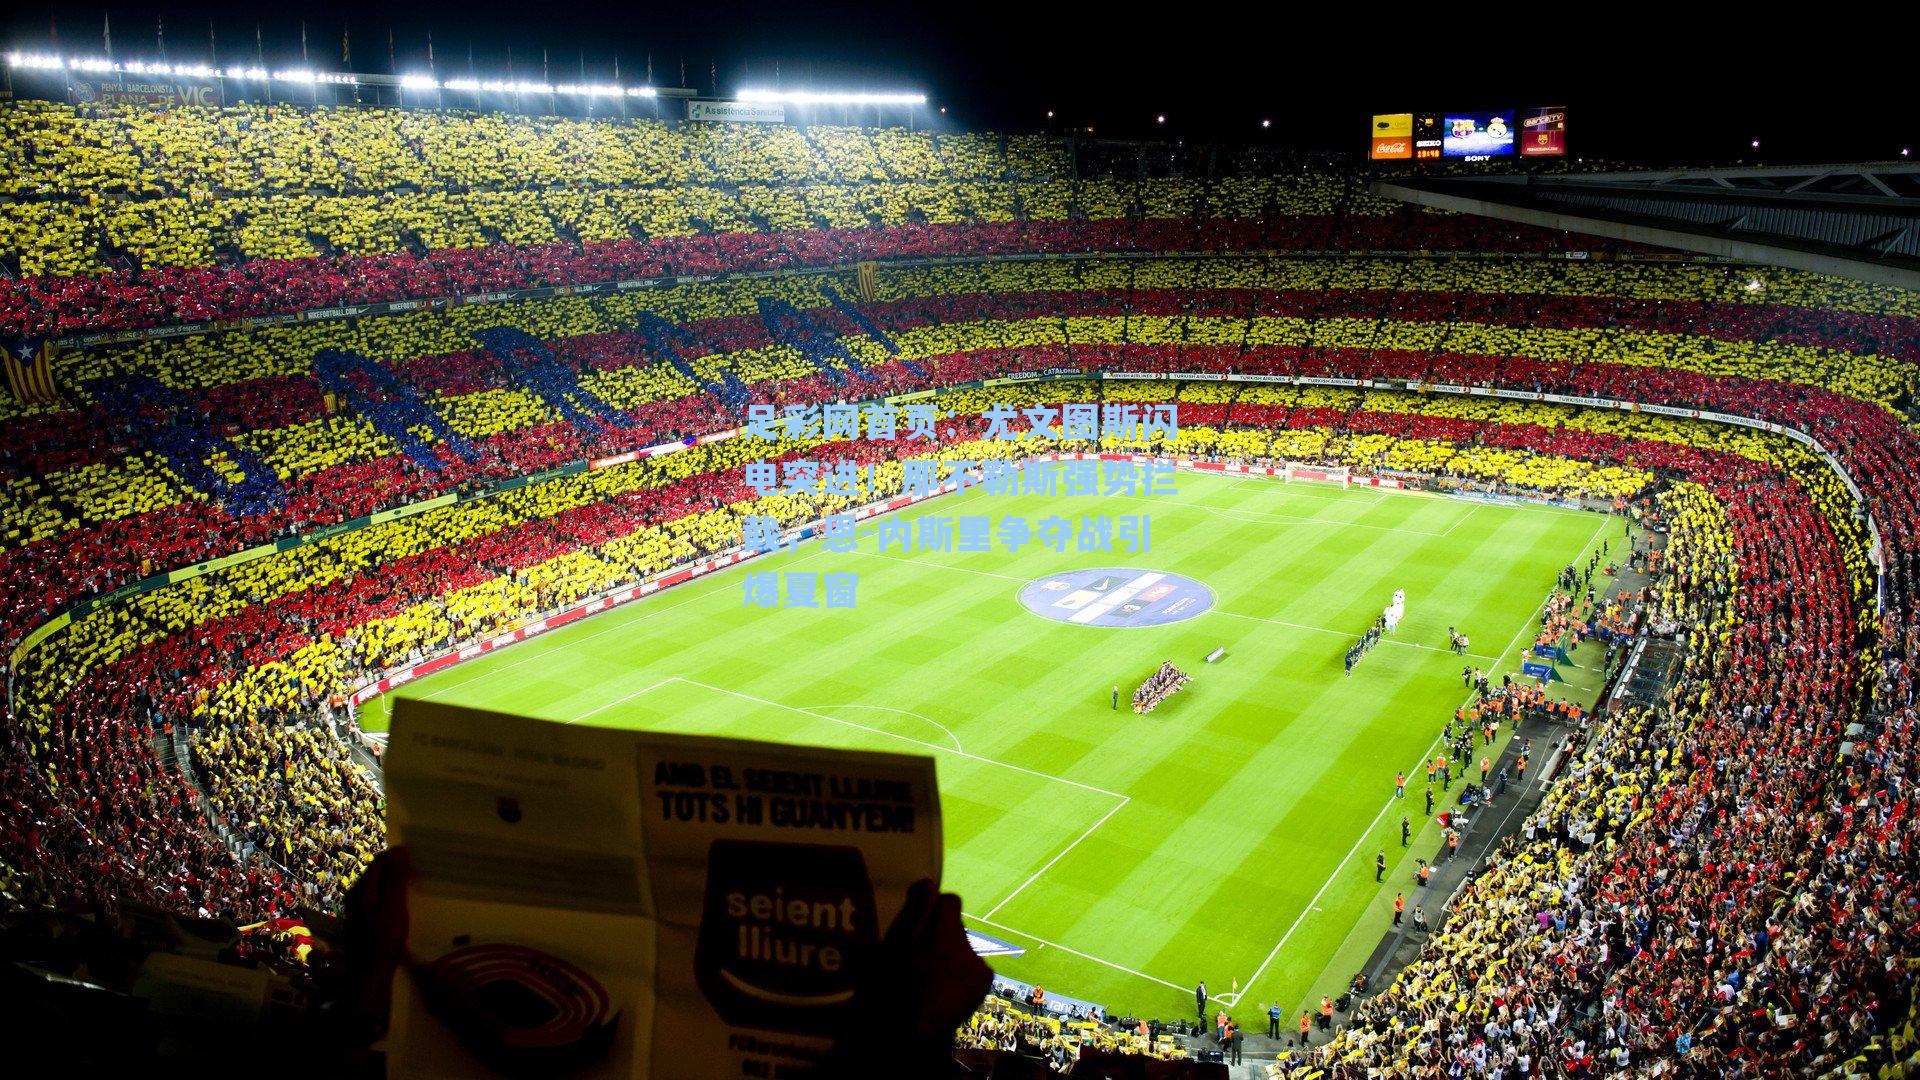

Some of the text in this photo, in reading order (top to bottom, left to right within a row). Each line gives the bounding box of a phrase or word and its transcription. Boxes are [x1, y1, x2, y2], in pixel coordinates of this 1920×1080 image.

[177, 85, 214, 106] VIC
[1007, 371, 1038, 380] FREEDOM
[1661, 408, 1689, 417] AIRLINES
[1714, 414, 1740, 424] TURKISH
[658, 790, 730, 824] TOTS
[735, 795, 763, 825] HI
[725, 884, 857, 934] seient
[738, 923, 844, 975] lliure
